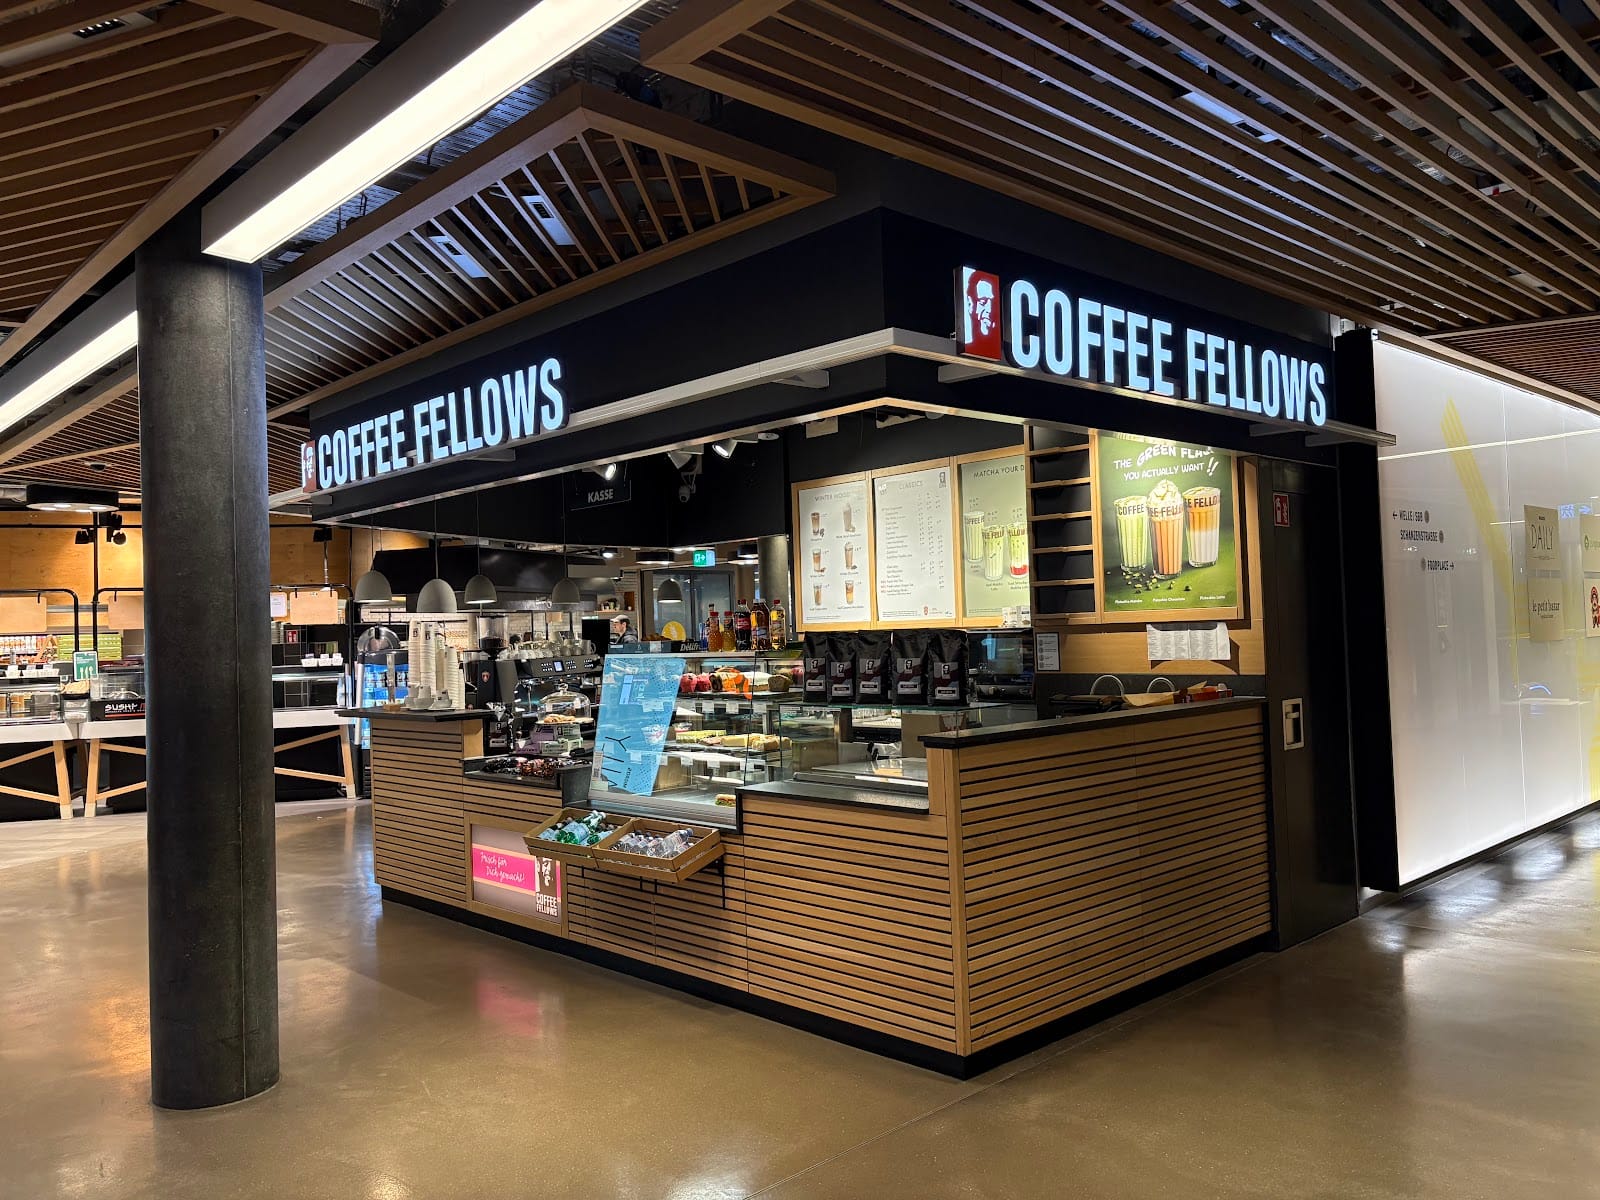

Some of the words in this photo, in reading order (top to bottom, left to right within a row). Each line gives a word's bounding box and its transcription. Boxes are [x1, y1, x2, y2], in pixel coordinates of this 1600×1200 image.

[1010, 279, 1175, 397] COFFEE
[1186, 327, 1327, 427] FELLOWS
[317, 409, 408, 489] COFFEE
[413, 357, 564, 464] FELLOWS
[1113, 458, 1133, 470] THE
[1136, 444, 1177, 467] GREEN
[973, 469, 1000, 478] MATCHA
[1001, 465, 1019, 474] YOUR
[1123, 471, 1140, 481] YOU
[1141, 465, 1179, 479] ACTUALLY
[1181, 462, 1205, 473] WANT
[587, 488, 614, 503] KASSE
[1118, 503, 1145, 514] COFFEE
[1531, 523, 1554, 550] DAILY
[486, 866, 499, 877] Dich
[536, 892, 557, 908] COFFEE
[536, 903, 558, 917] FELLOWS
